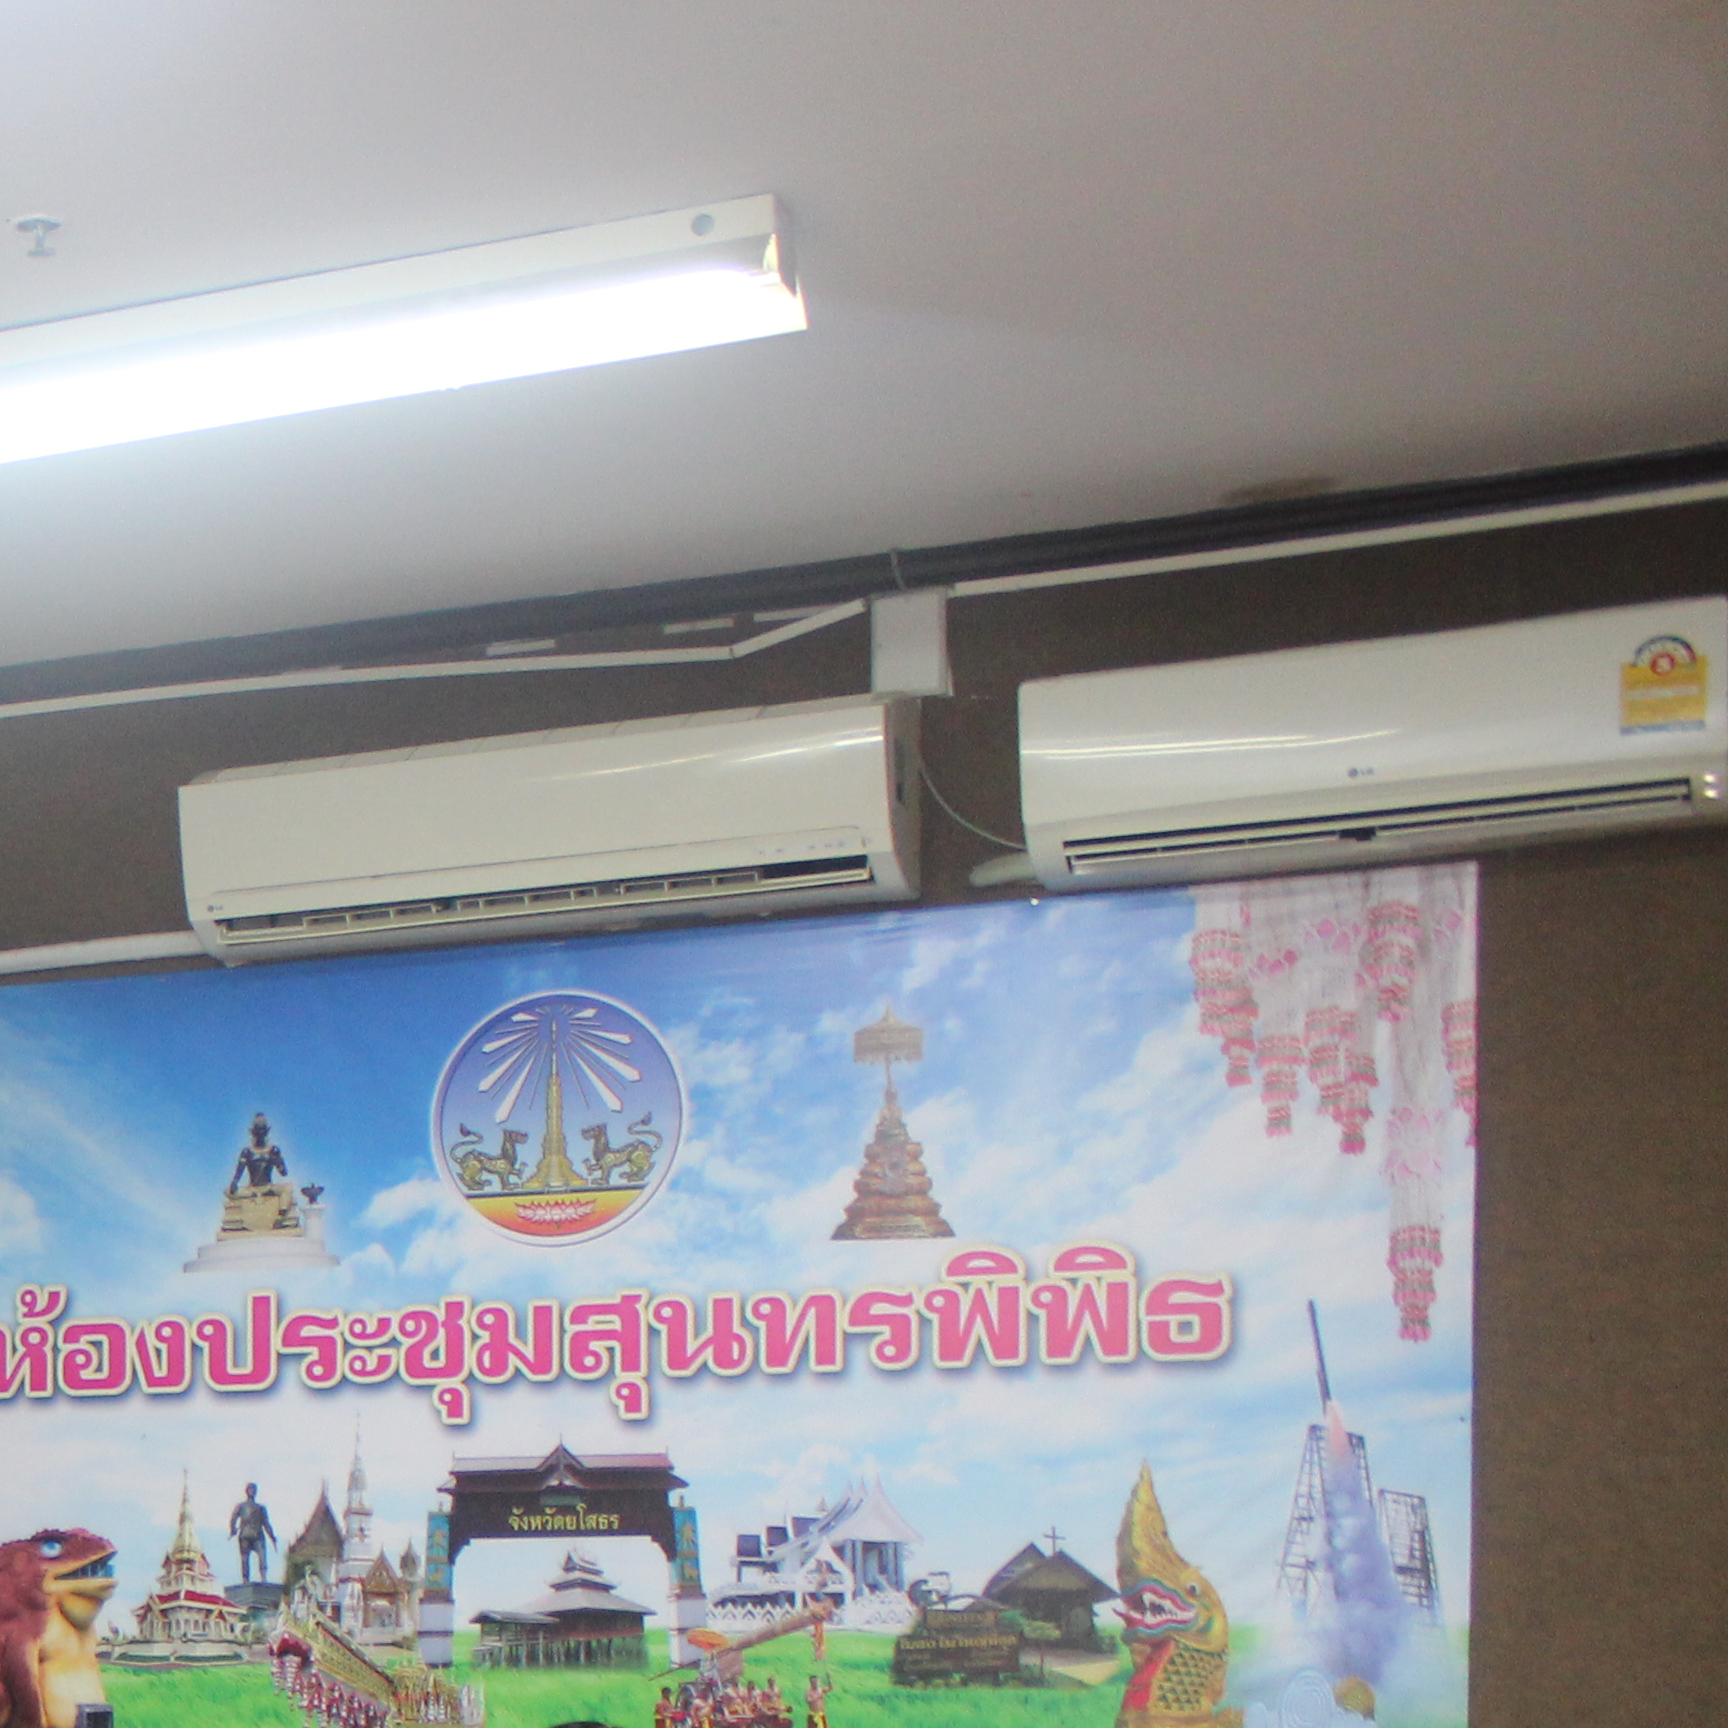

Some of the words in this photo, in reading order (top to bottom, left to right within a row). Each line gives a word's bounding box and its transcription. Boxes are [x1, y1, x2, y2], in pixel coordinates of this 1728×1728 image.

[507, 1503, 621, 1532] จังหวัดยโสธร
